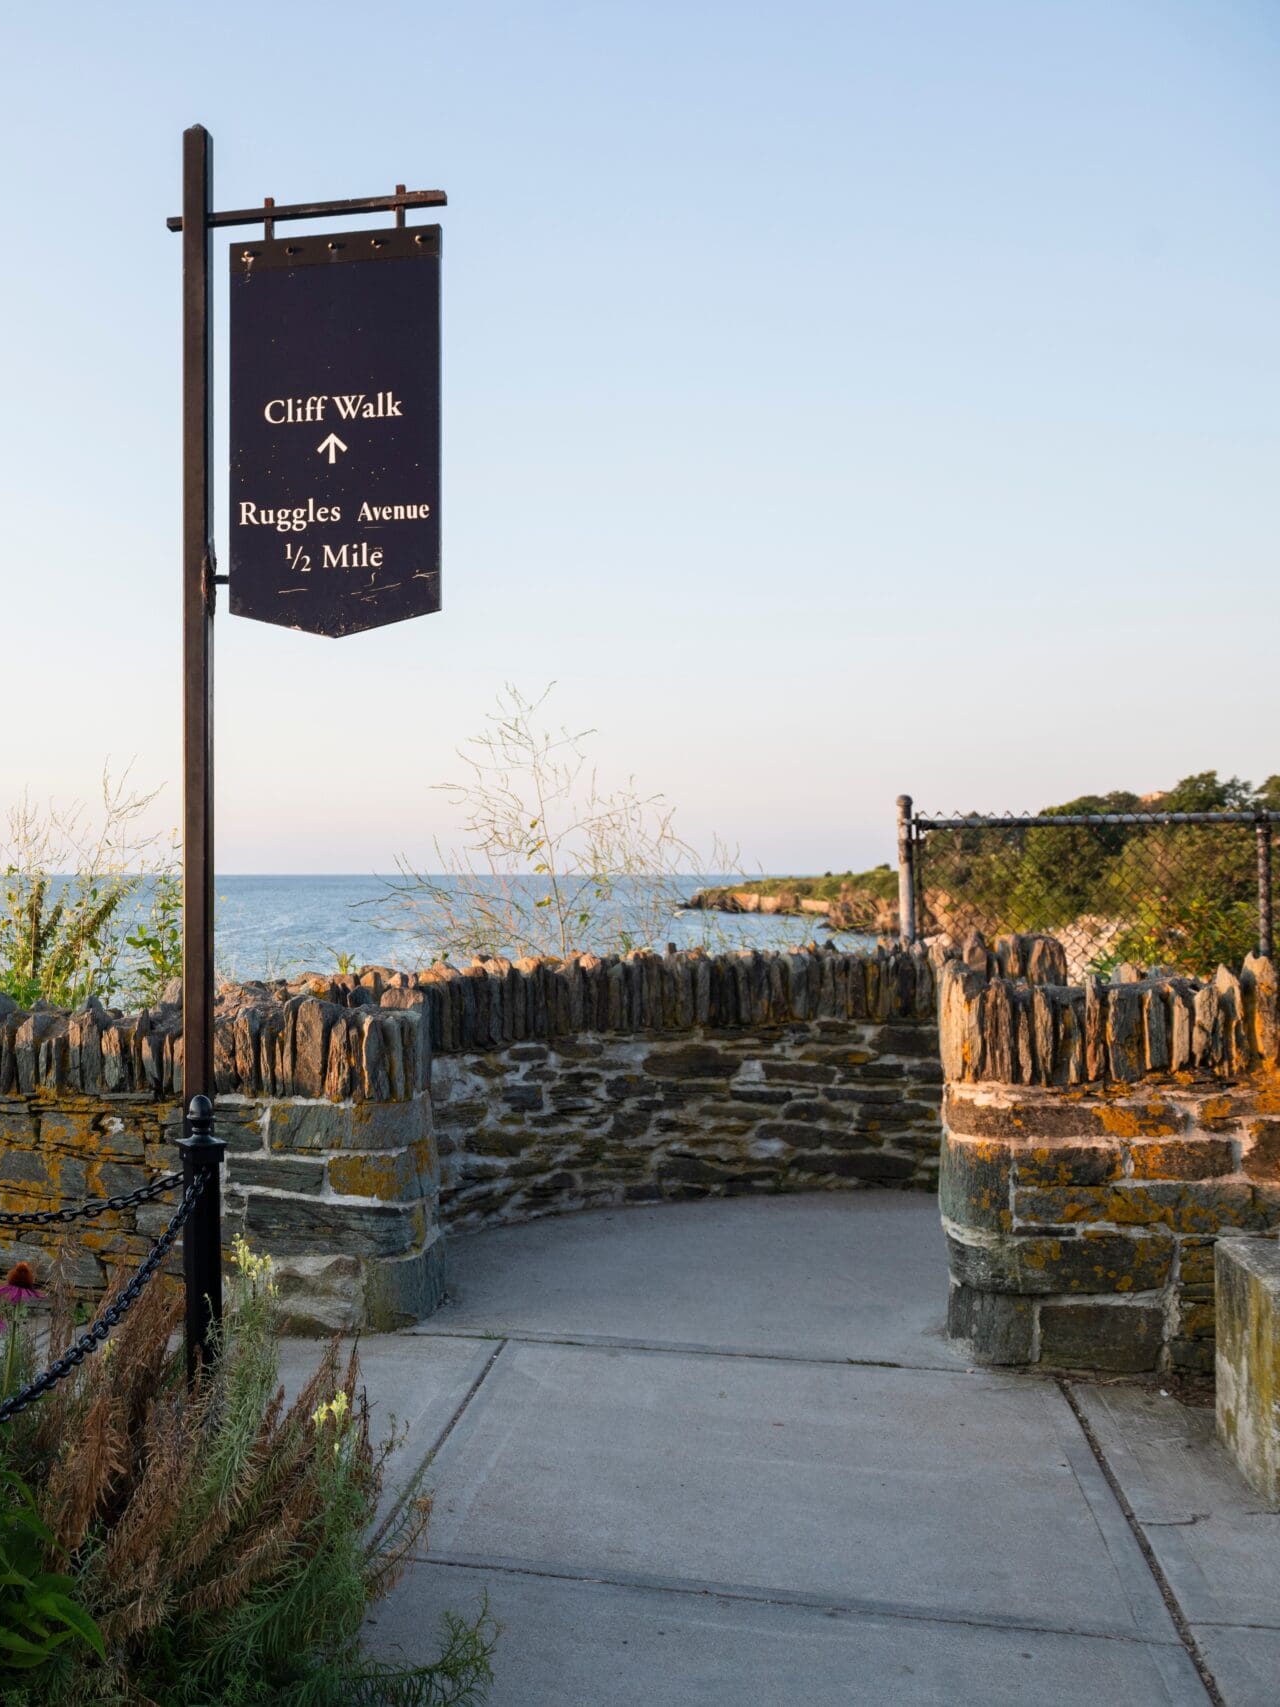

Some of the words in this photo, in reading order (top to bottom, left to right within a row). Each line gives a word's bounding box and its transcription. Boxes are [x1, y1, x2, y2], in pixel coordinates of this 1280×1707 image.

[264, 395, 328, 424] Cliff
[332, 391, 403, 420] Walk
[239, 498, 341, 533] Ruggles
[357, 502, 430, 522] Avenue
[322, 542, 384, 569] Mile
